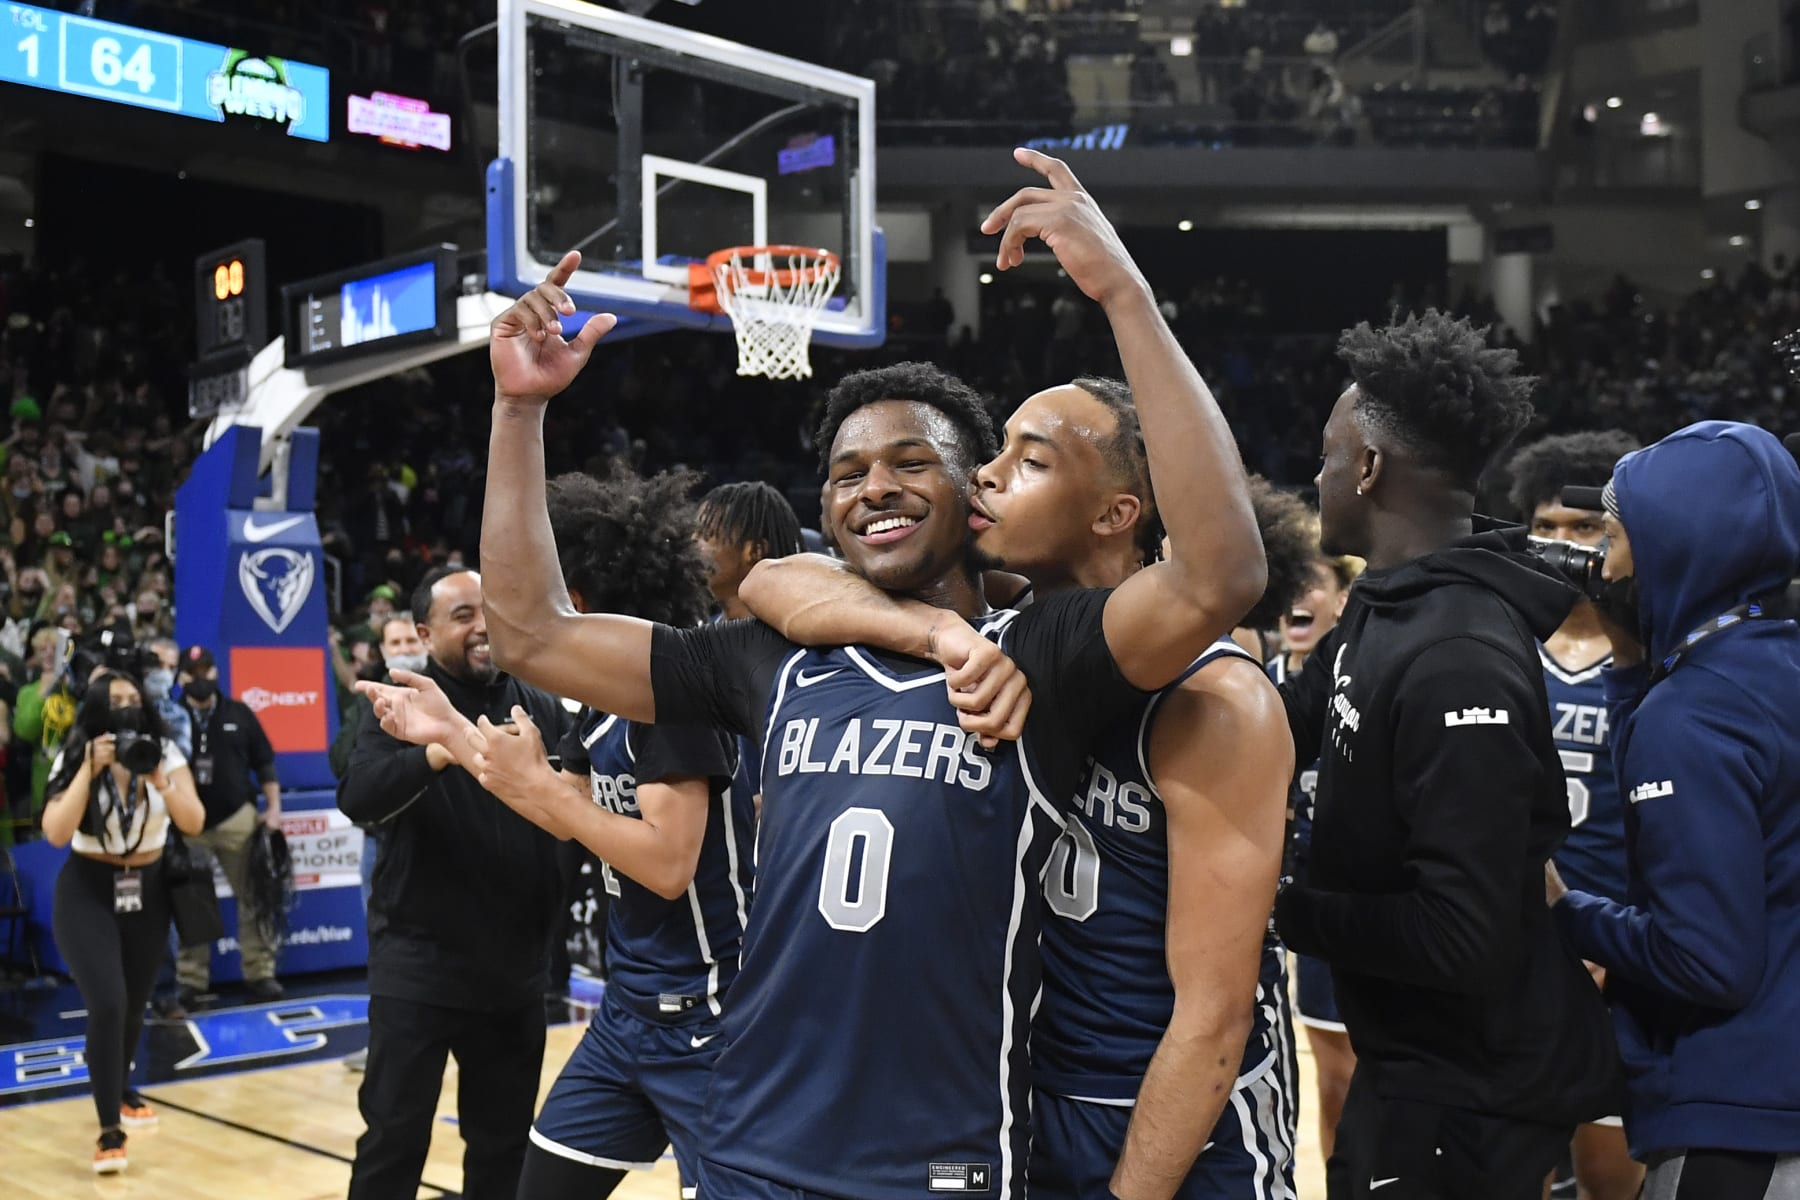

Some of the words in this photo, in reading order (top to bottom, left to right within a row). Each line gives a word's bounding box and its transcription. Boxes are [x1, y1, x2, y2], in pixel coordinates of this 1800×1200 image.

[9, 6, 48, 32] TOL
[18, 34, 39, 78] 1
[91, 37, 156, 94] 64
[271, 690, 318, 706] NEXT
[778, 718, 992, 791] BLAZERS
[316, 835, 348, 852] OF
[818, 806, 895, 933] 0
[972, 1171, 984, 1185] M
